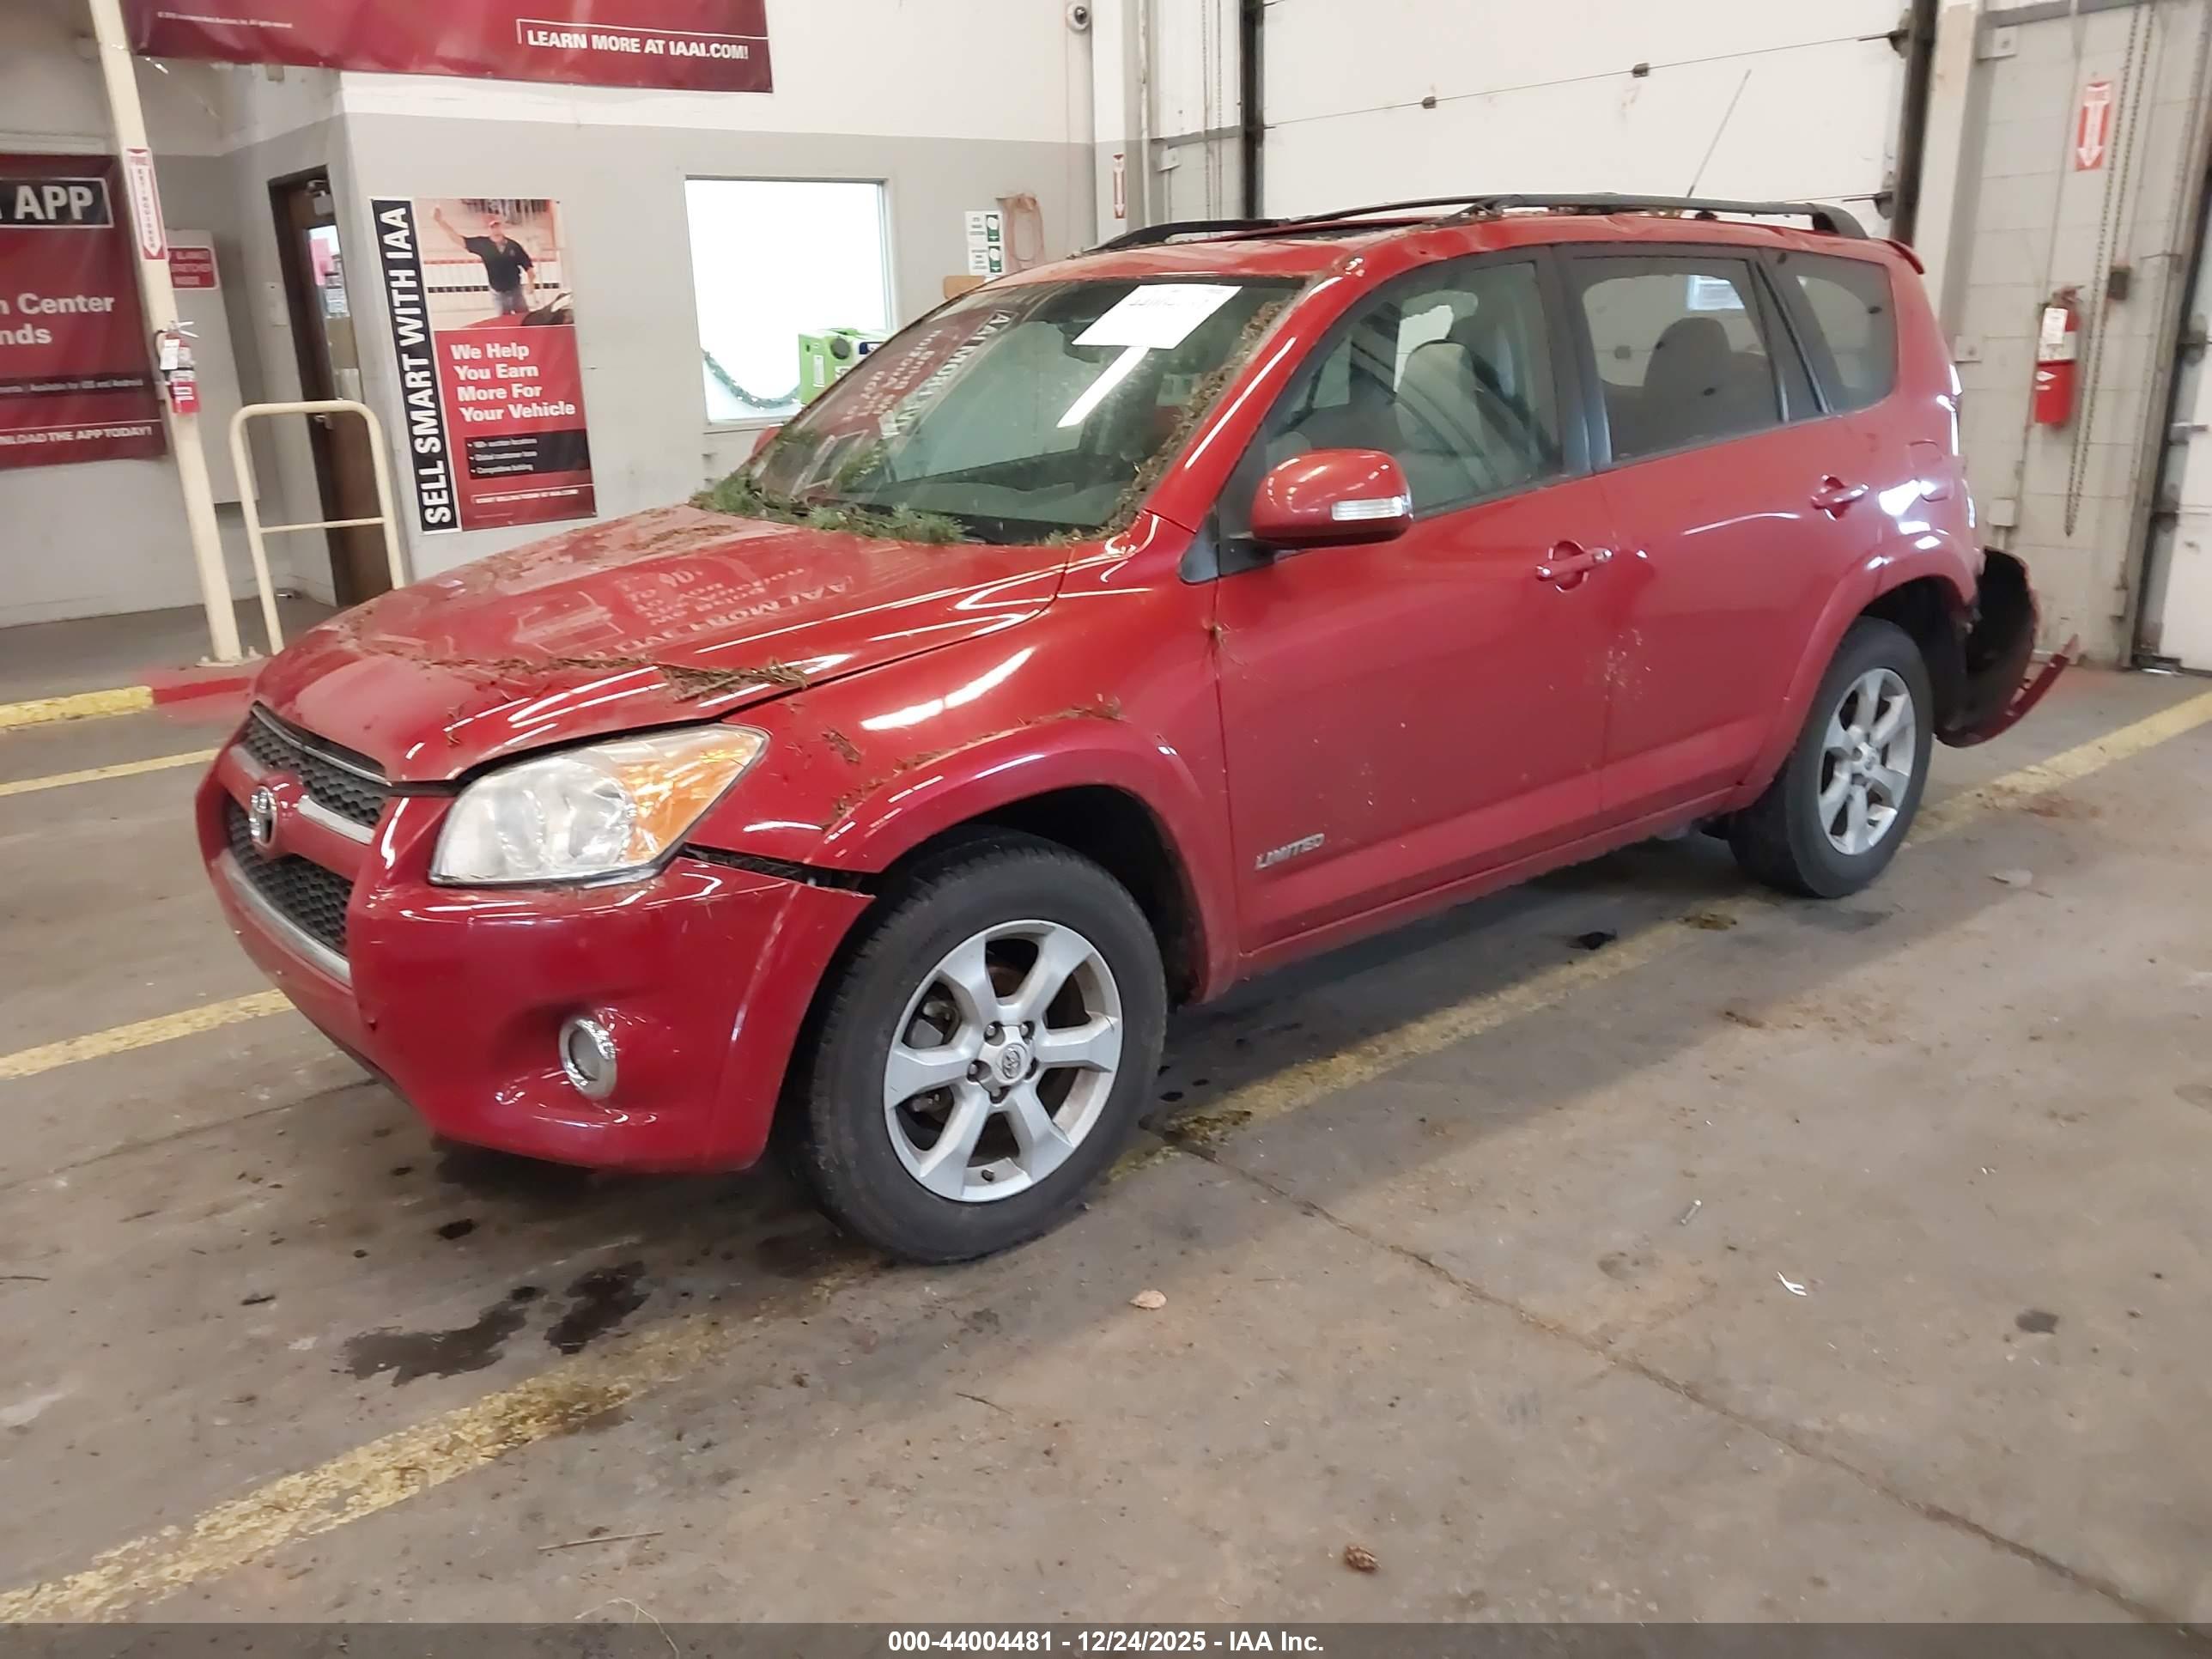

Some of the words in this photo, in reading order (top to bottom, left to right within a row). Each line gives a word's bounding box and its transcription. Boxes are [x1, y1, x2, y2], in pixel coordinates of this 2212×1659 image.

[526, 29, 587, 49] LEARN
[591, 34, 641, 53] MORE
[645, 39, 665, 55] AT
[669, 40, 749, 60] IAAI.COM!
[15, 185, 94, 220] APP
[380, 207, 413, 259] IAA
[17, 293, 115, 315] Center
[388, 269, 425, 347] WITH
[451, 344, 482, 360] We
[486, 342, 530, 361] Help
[453, 365, 491, 380] You
[495, 363, 539, 379] Earn
[401, 353, 441, 454] SMART
[457, 385, 507, 402] More
[511, 383, 543, 398] For
[459, 407, 505, 422] Your
[508, 400, 576, 419] Vehicle
[76, 429, 103, 440] APP
[419, 460, 452, 524] SELL
[1255, 832, 1325, 871] LIMITED
